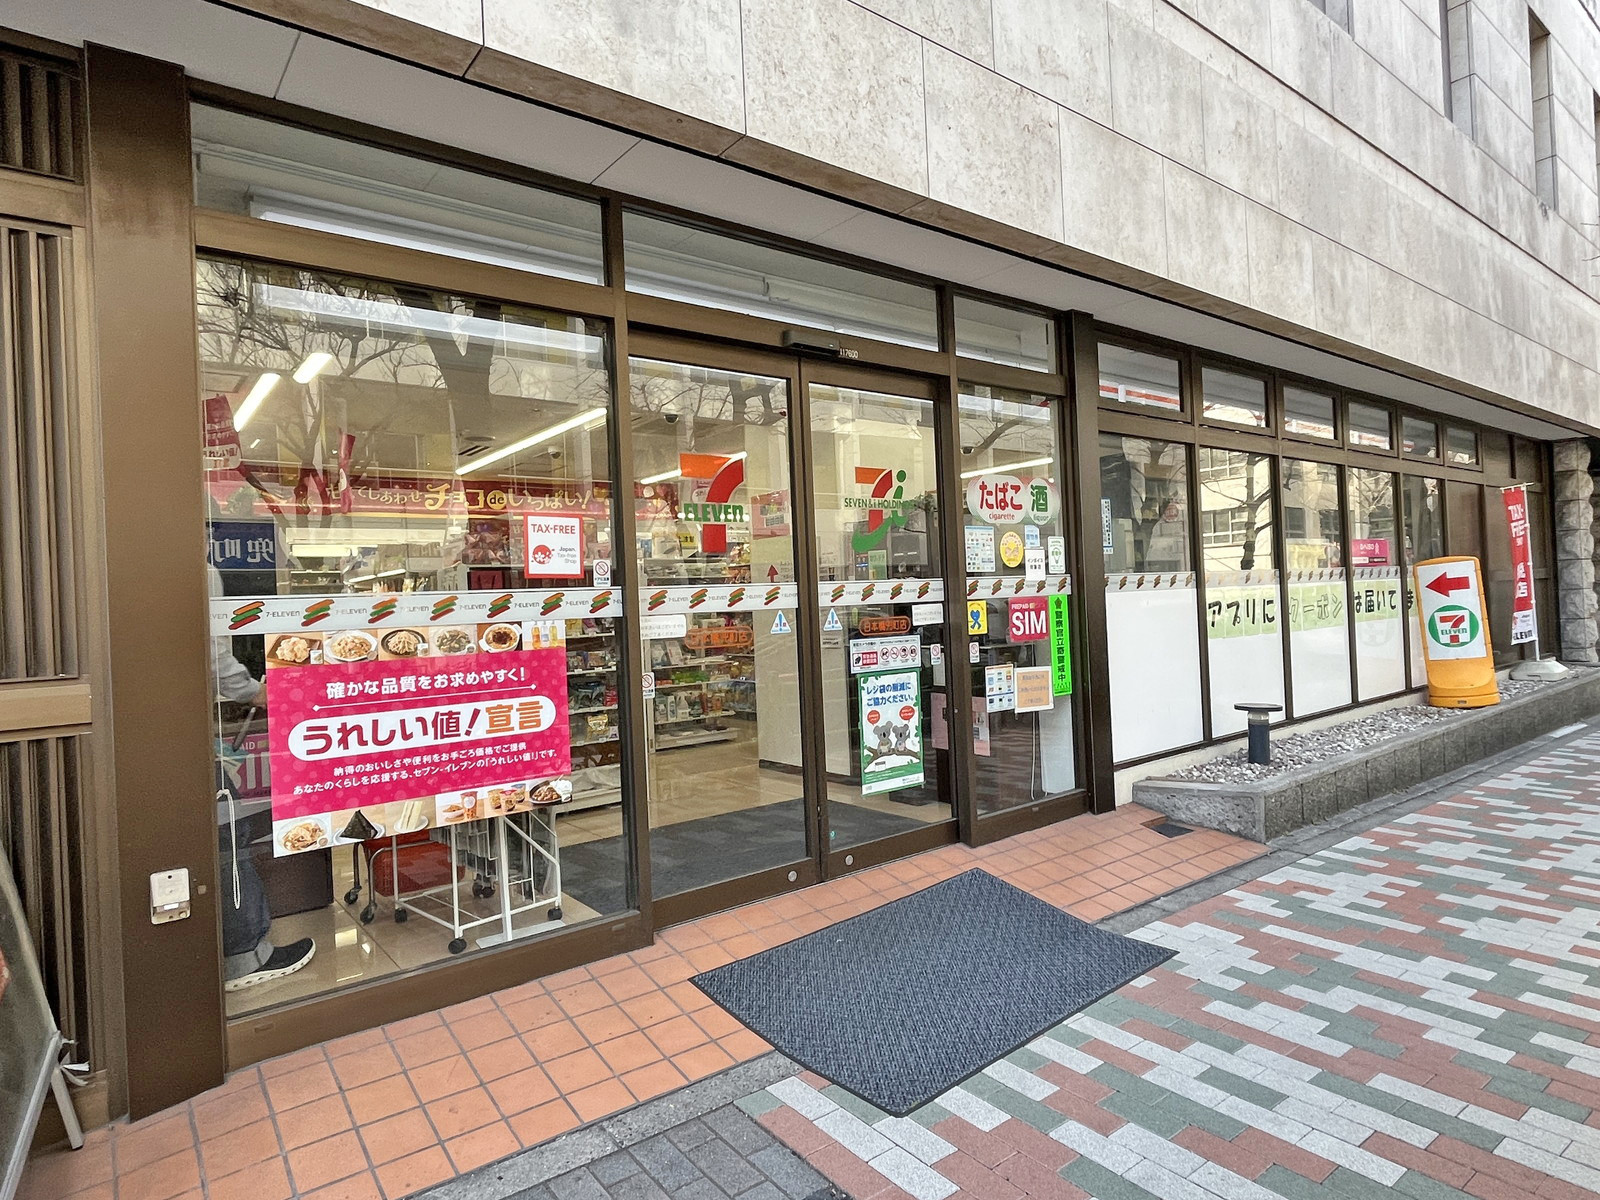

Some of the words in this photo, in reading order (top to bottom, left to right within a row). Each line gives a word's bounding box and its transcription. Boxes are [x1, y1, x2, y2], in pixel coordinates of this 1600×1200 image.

[877, 499, 916, 510] HOLDIN
[979, 481, 1023, 511] たばこ
[1030, 484, 1049, 512] 酒
[683, 503, 745, 522] ELEVEN
[988, 512, 1016, 521] cigarette
[531, 523, 576, 535] TAX-FREE
[266, 610, 300, 618] 7-ELEVEN
[1208, 598, 1275, 628] アプリに
[1289, 593, 1343, 623] クーポン
[1012, 610, 1047, 636] SIM
[1440, 628, 1468, 636] ELEVEN
[326, 666, 526, 699] 確かな品質をお求めやすく!
[866, 682, 911, 695] レジ袋の削減に
[867, 693, 914, 707] ご協力ください。
[302, 700, 543, 756] うれしい値!宣言
[333, 741, 527, 777] 納得のおいしさや便利をお手ごろ価格でご提供
